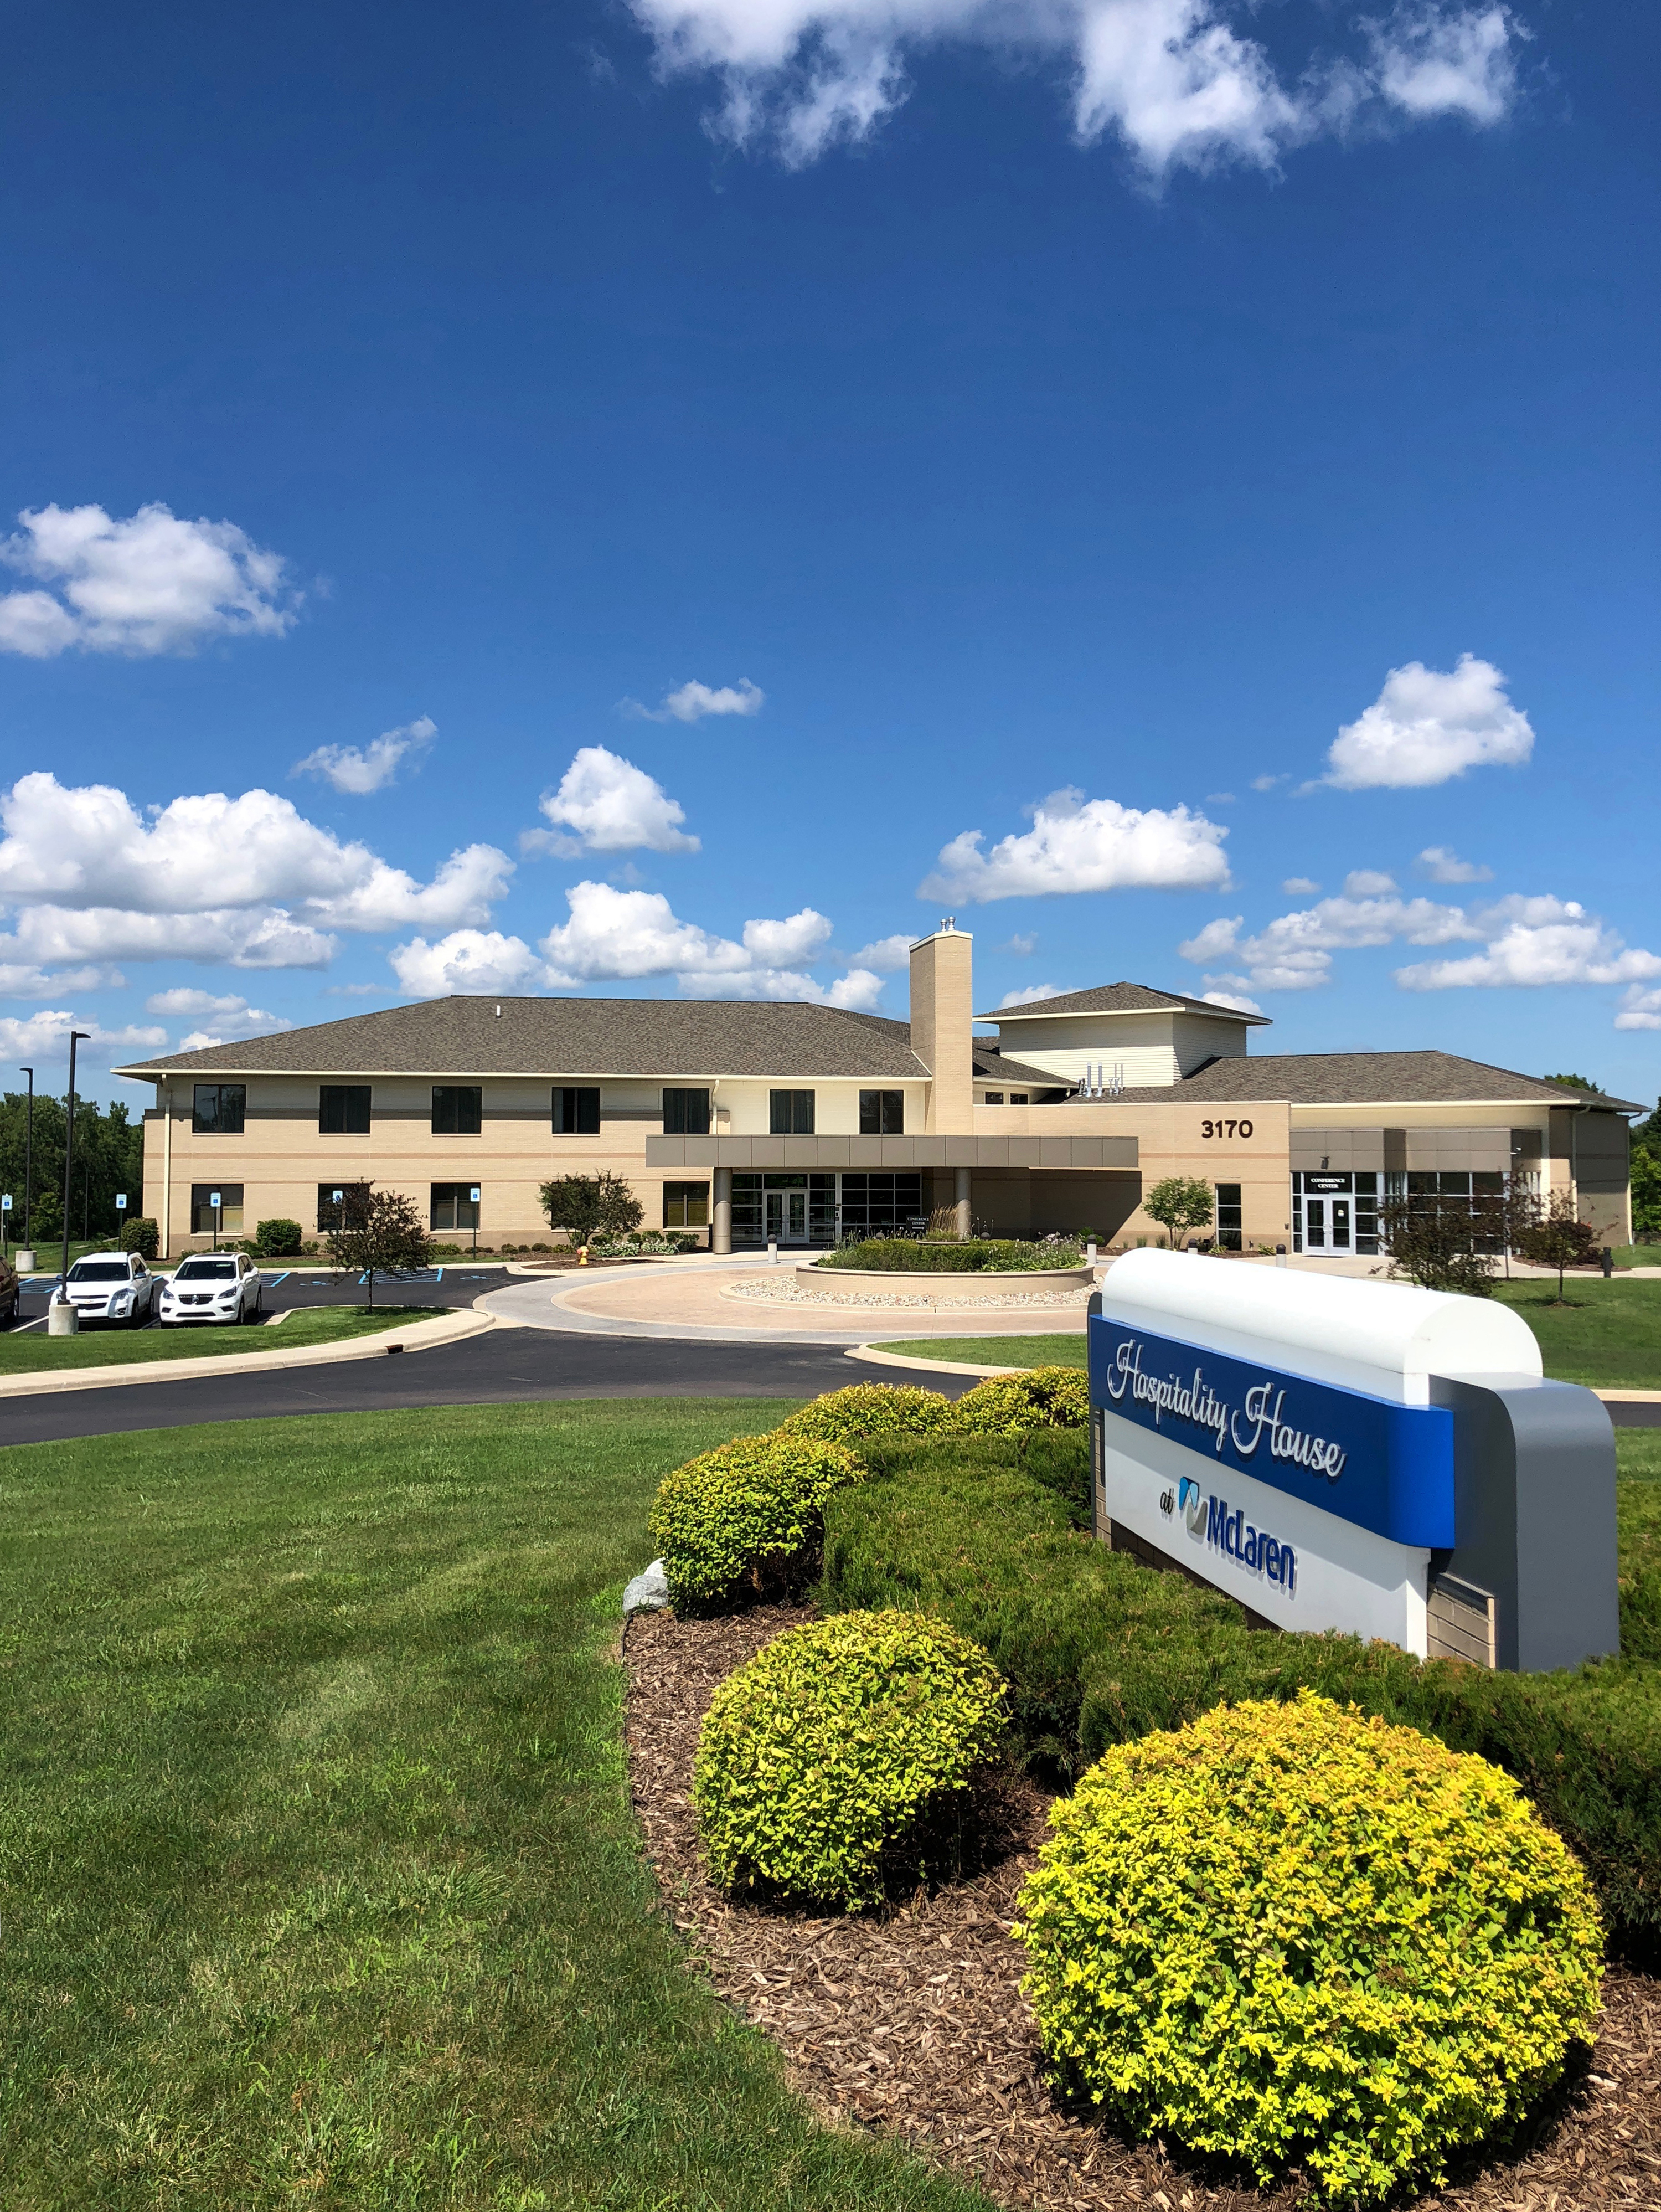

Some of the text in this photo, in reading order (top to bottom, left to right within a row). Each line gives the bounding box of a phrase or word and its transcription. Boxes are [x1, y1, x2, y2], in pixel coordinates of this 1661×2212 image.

[1201, 1120, 1254, 1139] 3170
[1107, 1339, 1347, 1477] Hospitality House
[1160, 1488, 1297, 1591] at McLaren
